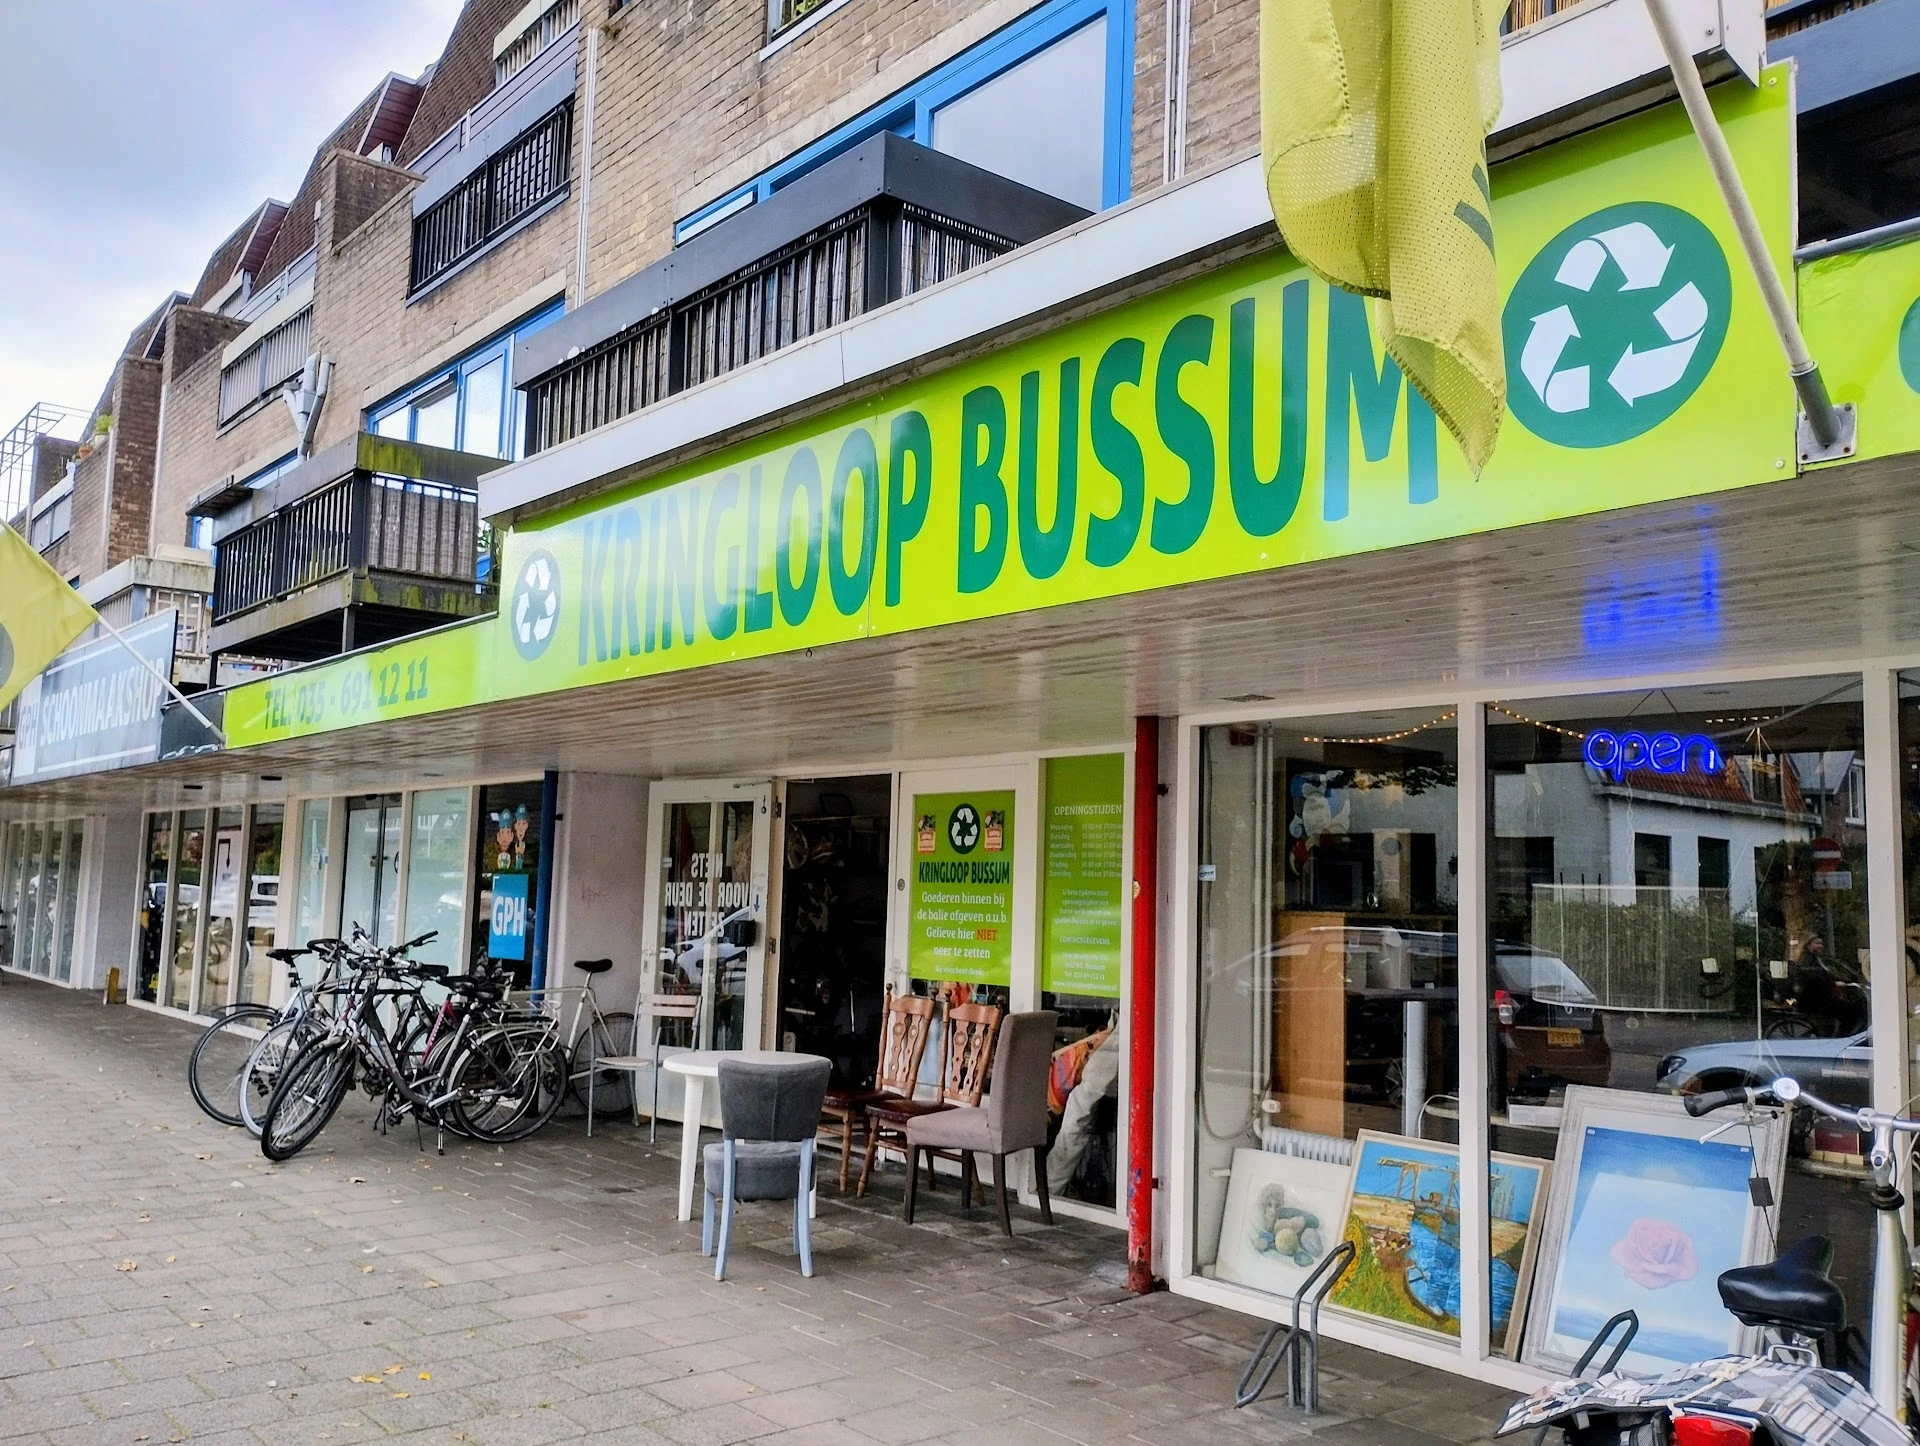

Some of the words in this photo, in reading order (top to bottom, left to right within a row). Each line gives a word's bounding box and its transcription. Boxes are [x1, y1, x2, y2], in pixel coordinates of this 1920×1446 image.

[577, 410, 933, 666] KRINGLOOP
[957, 279, 1438, 593] BUSSUM
[40, 657, 165, 747] SCHOONMAAKSHOP
[264, 688, 291, 730] TEL.
[299, 680, 326, 724] 035
[340, 669, 373, 717] 691
[377, 662, 400, 707] 12
[405, 655, 429, 701] 11
[1584, 729, 1720, 783] open
[919, 861, 969, 883] KRINGLOOP
[971, 861, 1010, 884] BUSSUM
[921, 891, 960, 903] Goederen
[962, 892, 991, 904] binnen
[993, 892, 1005, 908] bij
[492, 896, 525, 937] GPH
[917, 909, 926, 920] de
[928, 909, 948, 920] balie
[950, 910, 984, 924] afgeven
[926, 926, 956, 938] Gelieve
[958, 928, 975, 940] hier
[976, 929, 998, 941] NIET
[934, 946, 952, 956] neer
[954, 946, 962, 957] te
[964, 948, 990, 959] zetten
